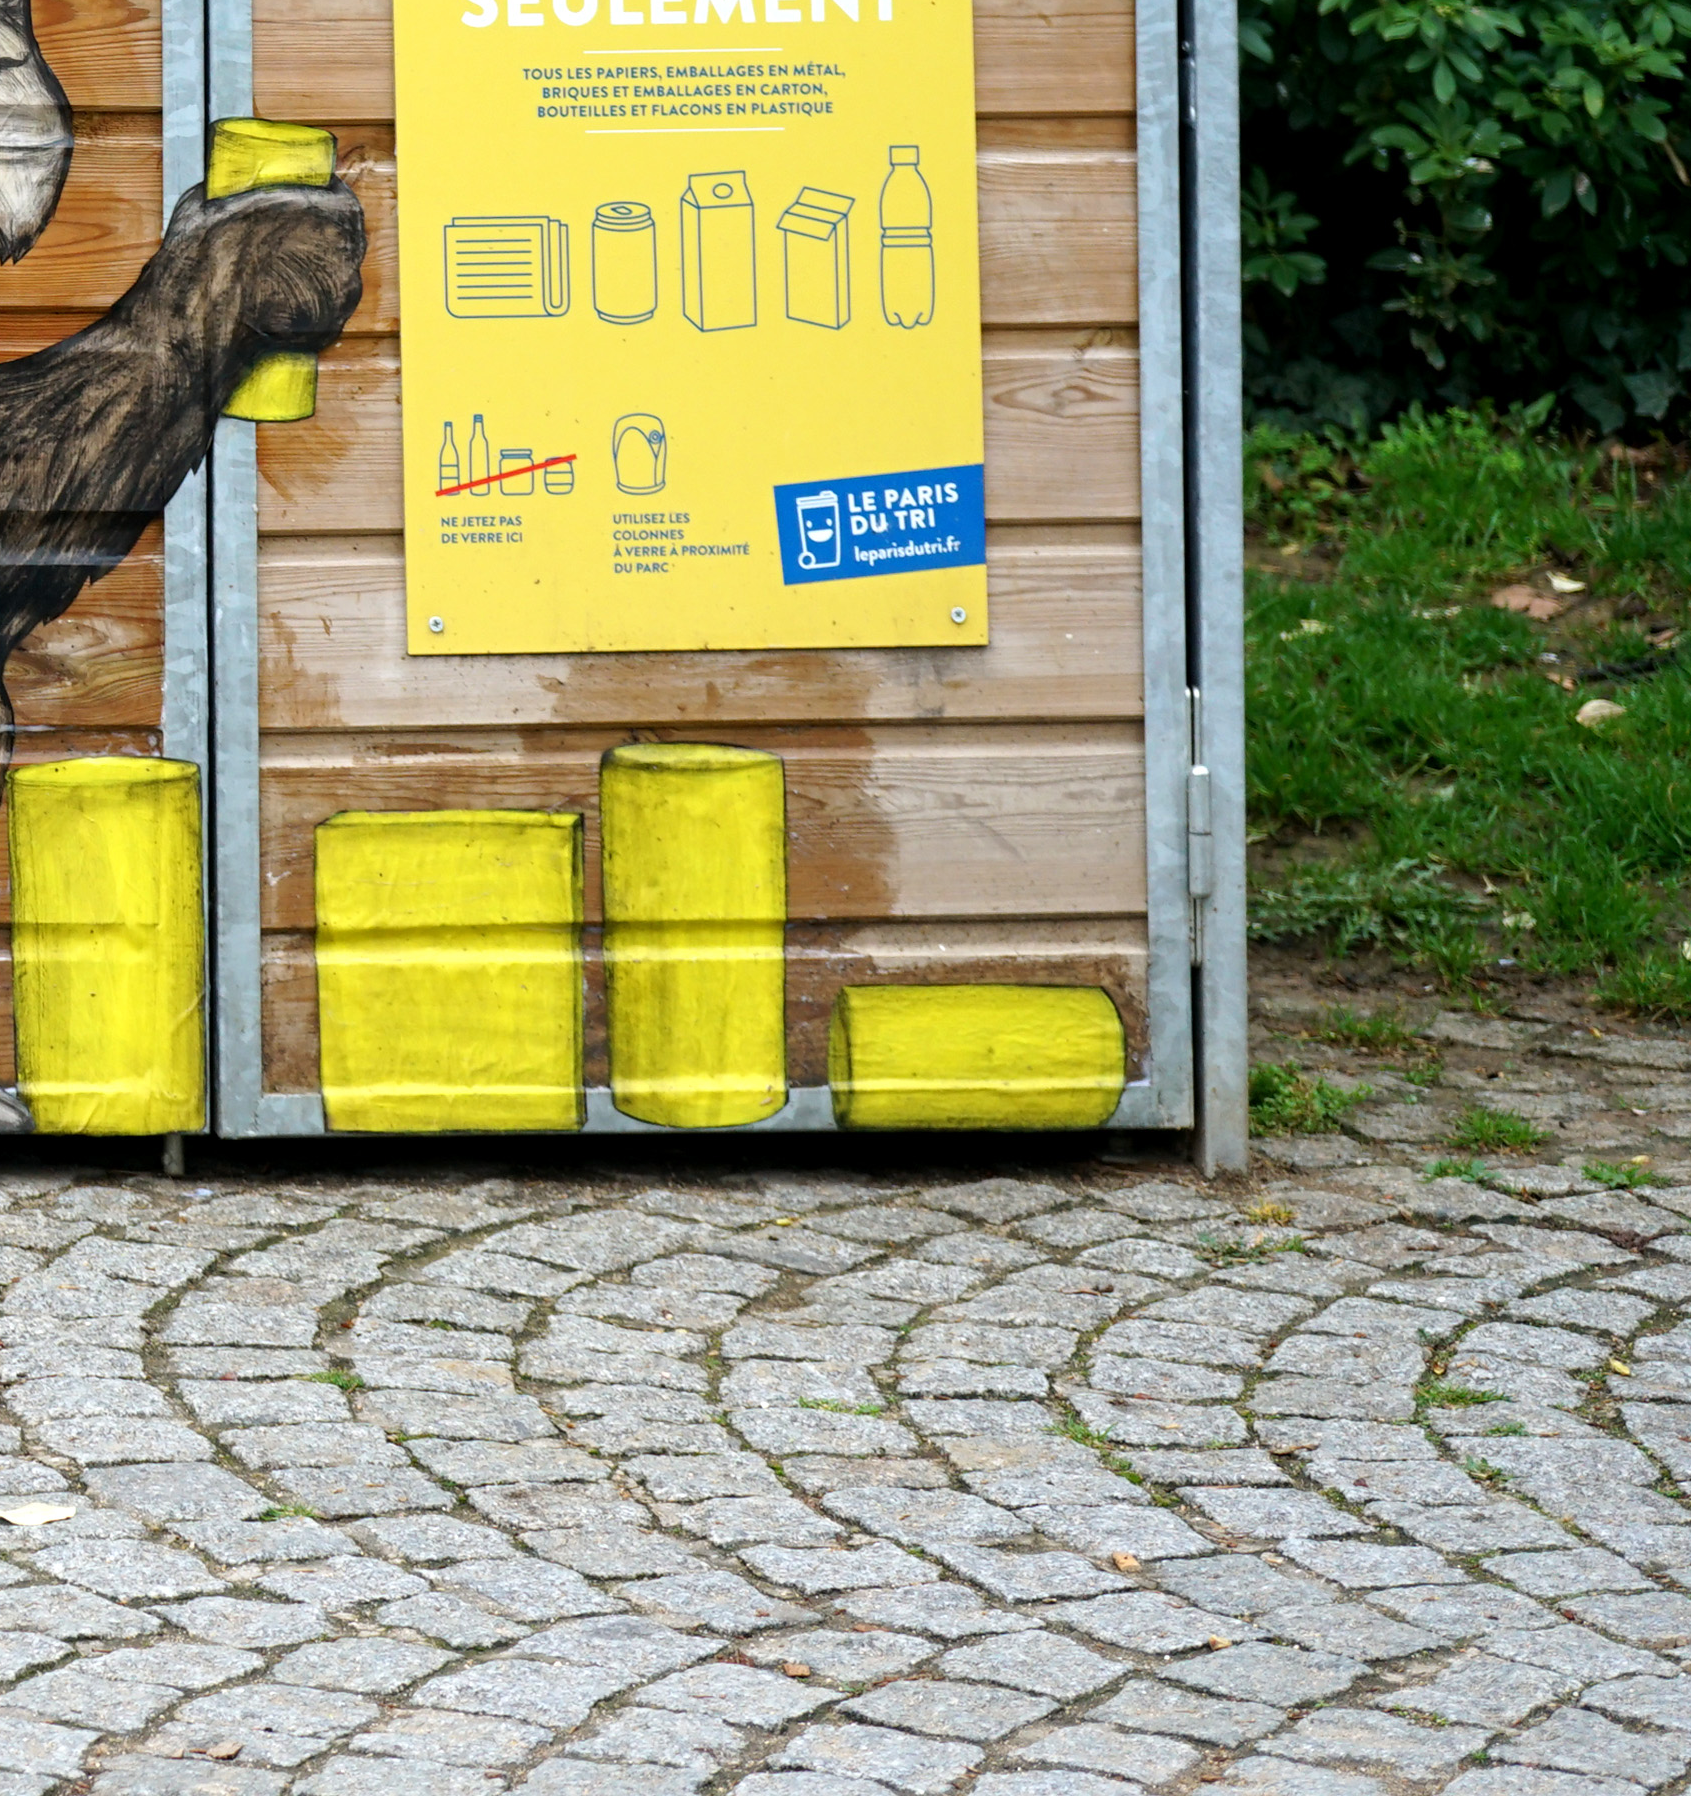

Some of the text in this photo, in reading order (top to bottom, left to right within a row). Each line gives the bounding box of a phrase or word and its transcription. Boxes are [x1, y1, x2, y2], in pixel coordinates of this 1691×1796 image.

[522, 60, 847, 82] TOUS LES PAPIERS, EMBALLAGES EN MÉTAL,
[541, 82, 828, 102] BRIQUES ET EMBALLAGES EN CARTON,
[536, 101, 834, 119] BOUTEILLES ET FLACONS EN PLASTIQUE
[847, 482, 959, 513] LE PARIS
[440, 515, 523, 528] NE JETEZ PAS
[612, 512, 691, 525] UTILISEZ LES
[849, 508, 936, 536] DU TRI
[440, 531, 523, 545] DE VERRE ICI
[612, 528, 685, 541] COLONNES
[623, 545, 667, 557] VERRE
[680, 542, 750, 557] PROXIMITÉ
[853, 535, 961, 567] leparisdutri.fr
[613, 561, 669, 574] DU PARC
